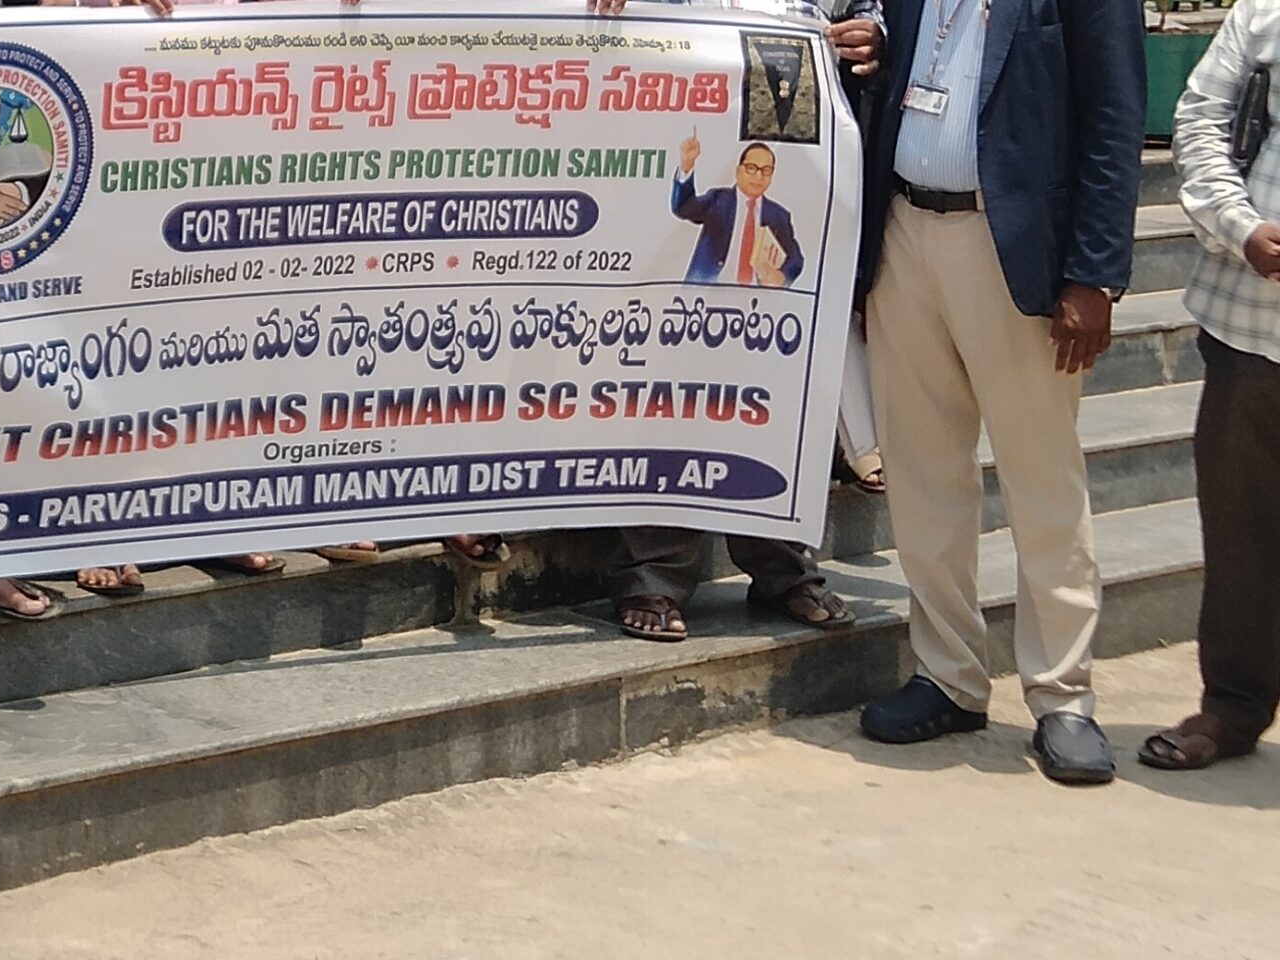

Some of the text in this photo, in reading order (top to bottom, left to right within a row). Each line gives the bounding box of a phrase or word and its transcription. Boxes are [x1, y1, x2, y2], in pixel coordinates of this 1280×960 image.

[159, 36, 198, 52] మనము
[322, 31, 348, 47] రండి
[349, 32, 368, 47] అని
[417, 32, 448, 47] మంచి
[540, 33, 573, 48] బలము
[101, 62, 299, 144] క్రిస్టియన్స్
[308, 58, 397, 131] రైట్స్
[597, 64, 729, 115] సమితి
[52, 120, 70, 169] SAMITI
[100, 148, 666, 193] CHRISTIANS RIGHTS PROTECTION SAMITI
[27, 199, 54, 228] INDIA
[181, 198, 580, 244] FOR THE WELFARE OF CHRISTIANS
[130, 260, 238, 289] Established
[242, 260, 264, 281] 02
[311, 255, 356, 277] 2022
[382, 252, 435, 274] CRPS
[563, 250, 582, 272] of
[587, 251, 632, 271] 2022
[32, 275, 83, 299] SERVE
[0, 317, 153, 410] రాజ్యాంగం
[159, 325, 248, 371] మరియు
[251, 305, 322, 361] మత
[508, 296, 652, 367] హక్కులపై
[659, 296, 802, 357] పోరాటం
[38, 394, 308, 461] CHRISTIANS
[319, 384, 507, 432] DEMAND
[517, 380, 579, 421] SC
[589, 380, 772, 427] STATUS
[263, 438, 382, 464] Organizers
[39, 476, 304, 528] PARVATIPURAM
[313, 463, 459, 504] MANYAM
[468, 460, 546, 493] DIST
[554, 457, 649, 489] TEAM
[676, 459, 729, 491] AP
